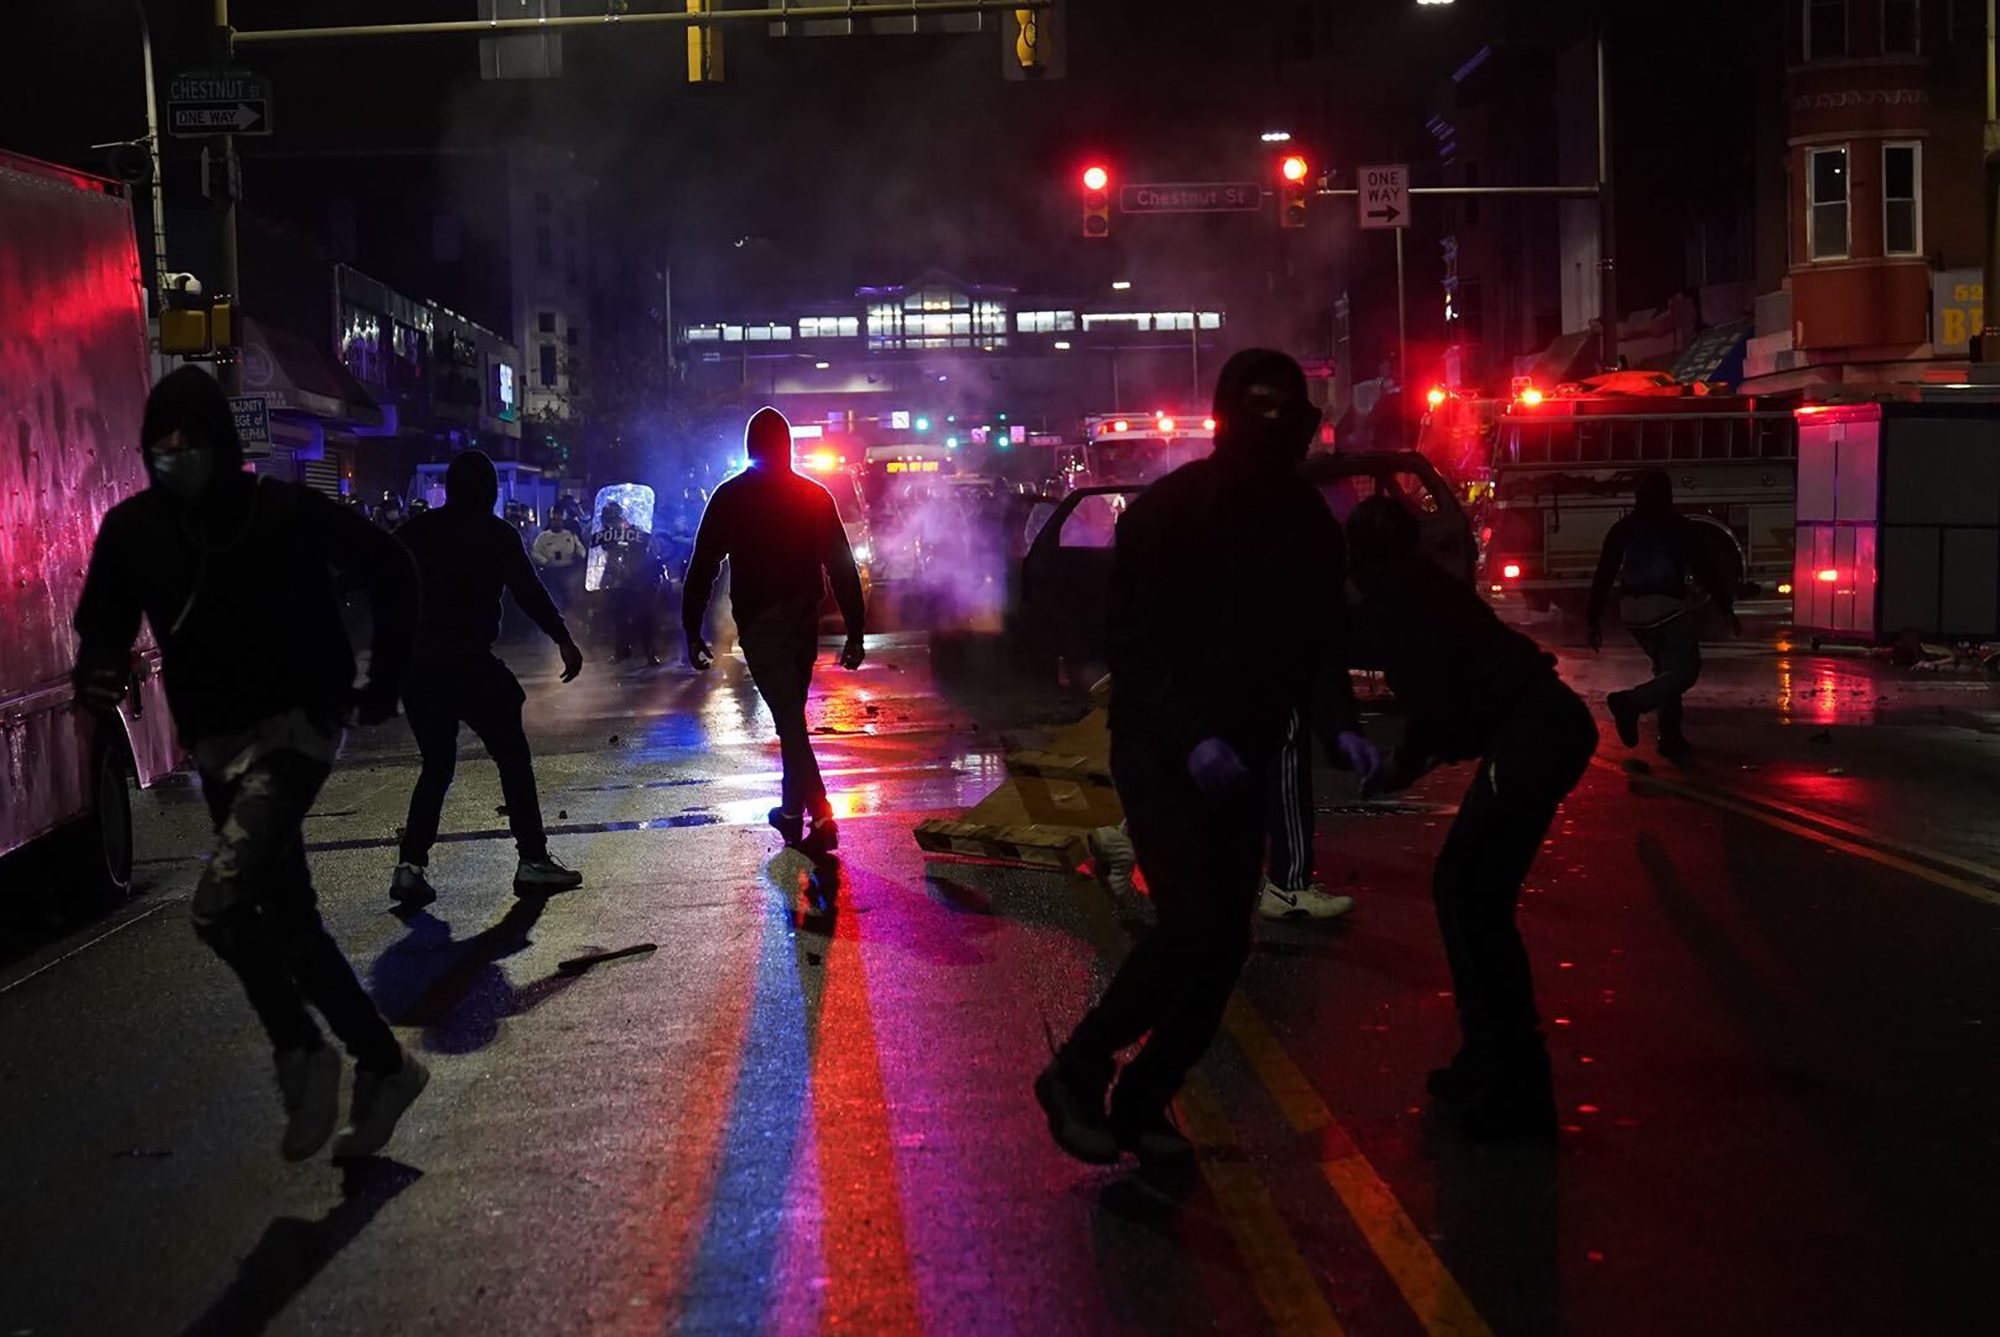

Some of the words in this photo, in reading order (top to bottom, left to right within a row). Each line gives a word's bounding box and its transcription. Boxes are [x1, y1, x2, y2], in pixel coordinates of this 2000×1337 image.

[170, 80, 244, 99] CHESTNUT
[179, 111, 206, 124] ONE
[209, 111, 236, 123] WAY
[1368, 171, 1399, 186] ONE
[1137, 188, 1218, 206] Chestnut
[1226, 187, 1244, 205] St
[1368, 187, 1400, 202] WAY
[229, 400, 263, 414] MUNITY
[234, 414, 251, 428] EGE
[594, 528, 644, 544] POLICE
